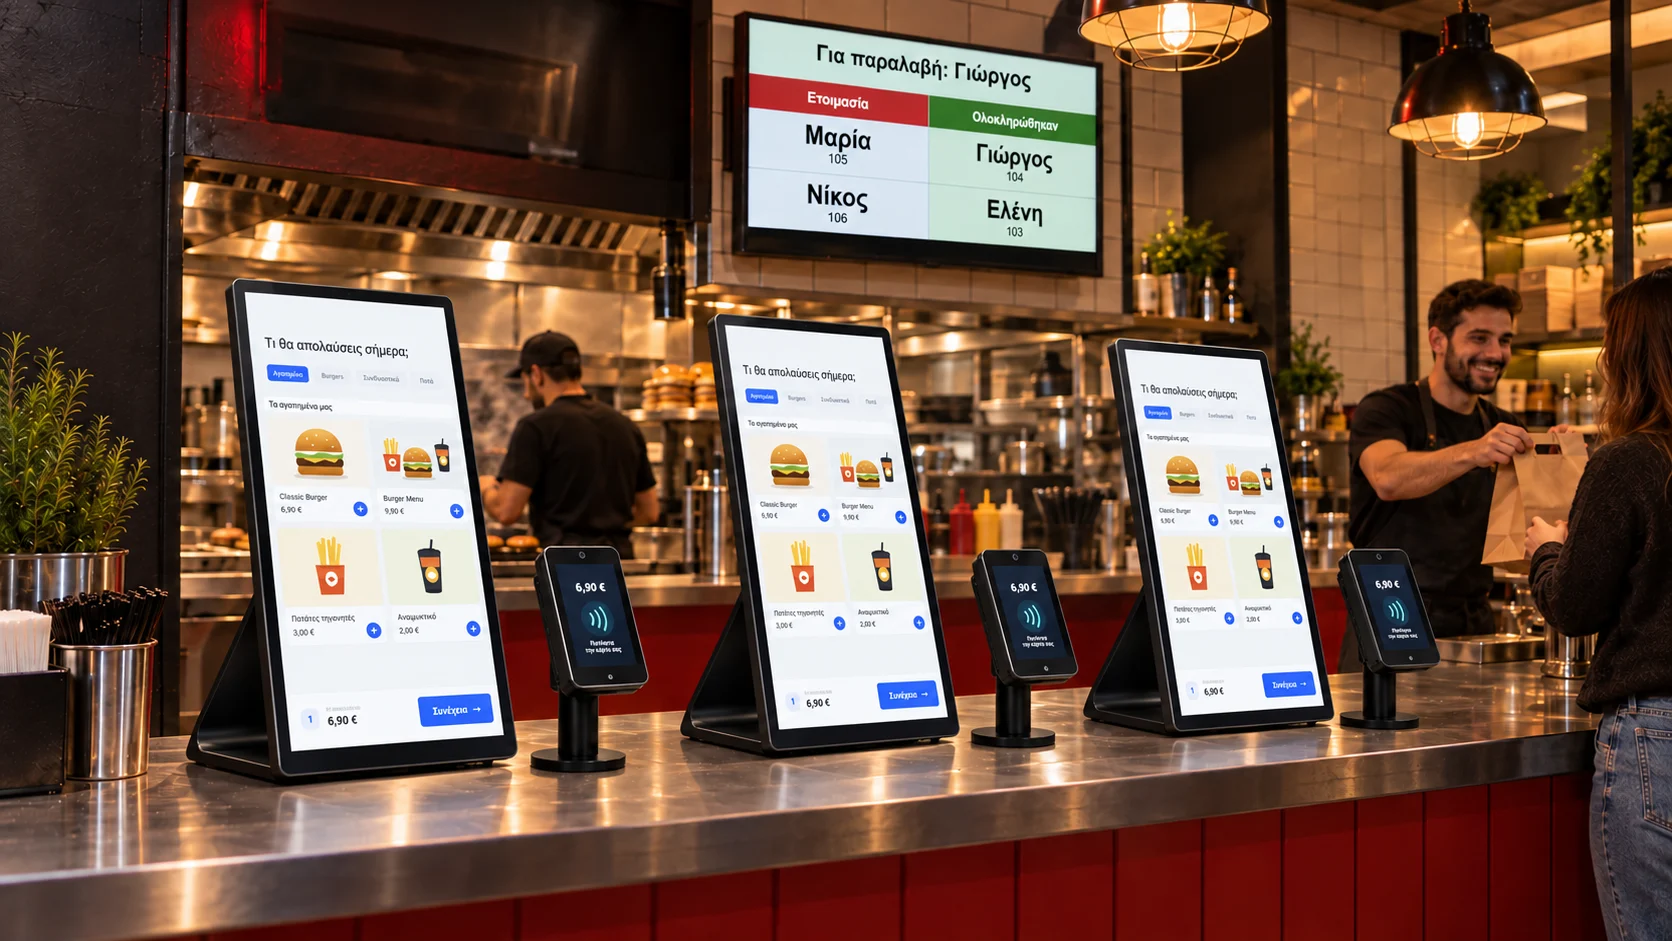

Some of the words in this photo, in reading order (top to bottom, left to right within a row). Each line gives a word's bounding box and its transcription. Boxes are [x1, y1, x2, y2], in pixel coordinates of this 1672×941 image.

[816, 44, 845, 64] Για
[851, 51, 949, 80] παραλαβή:
[954, 62, 1032, 92] Γιώργος
[807, 91, 869, 110] Ετοιμασία
[972, 111, 1059, 133] Ολοκληρώθηκαν
[805, 124, 871, 152] Μαρία
[828, 154, 848, 165] 105
[976, 143, 1053, 173] Γιώργος
[1006, 172, 1024, 183] 104
[807, 183, 868, 213] Νίκος
[828, 212, 848, 224] 106
[987, 199, 1043, 227] Ελένη
[1006, 226, 1024, 238] 103
[264, 336, 276, 349] Τι
[279, 338, 294, 350] θα
[297, 340, 363, 357] απολαύσεις
[365, 344, 409, 359] σήμερα;
[321, 373, 344, 381] Burgers
[743, 365, 752, 375] Τι
[754, 365, 766, 376] θα
[768, 367, 820, 381] απολαύσεις
[821, 370, 856, 383] σήμερα;
[1140, 384, 1149, 393] Τι
[1150, 384, 1161, 394] θα
[1162, 387, 1207, 398] απολαύσεις
[1207, 388, 1238, 400] σήμερα;
[268, 400, 278, 408] Τα
[279, 493, 304, 501] Classic
[305, 494, 328, 502] Burger
[383, 495, 404, 503] Burger
[280, 506, 296, 514] 6,90
[384, 508, 399, 516] 9,90
[575, 582, 597, 594] 6,90
[599, 582, 606, 592] €
[1010, 583, 1030, 594] 6,90
[1031, 583, 1038, 592] €
[1375, 580, 1393, 590] 6,90
[1394, 580, 1400, 588] €
[293, 629, 309, 637] 3,00
[310, 628, 315, 636] €
[399, 627, 413, 635] 2,00
[414, 626, 419, 634] €
[1204, 687, 1219, 696] 6,90
[806, 699, 824, 709] 6,90
[825, 698, 830, 707] €
[432, 706, 468, 717] Συνέχεια
[308, 715, 313, 723] 1
[327, 715, 349, 727] 6,90
[351, 715, 358, 725] €
